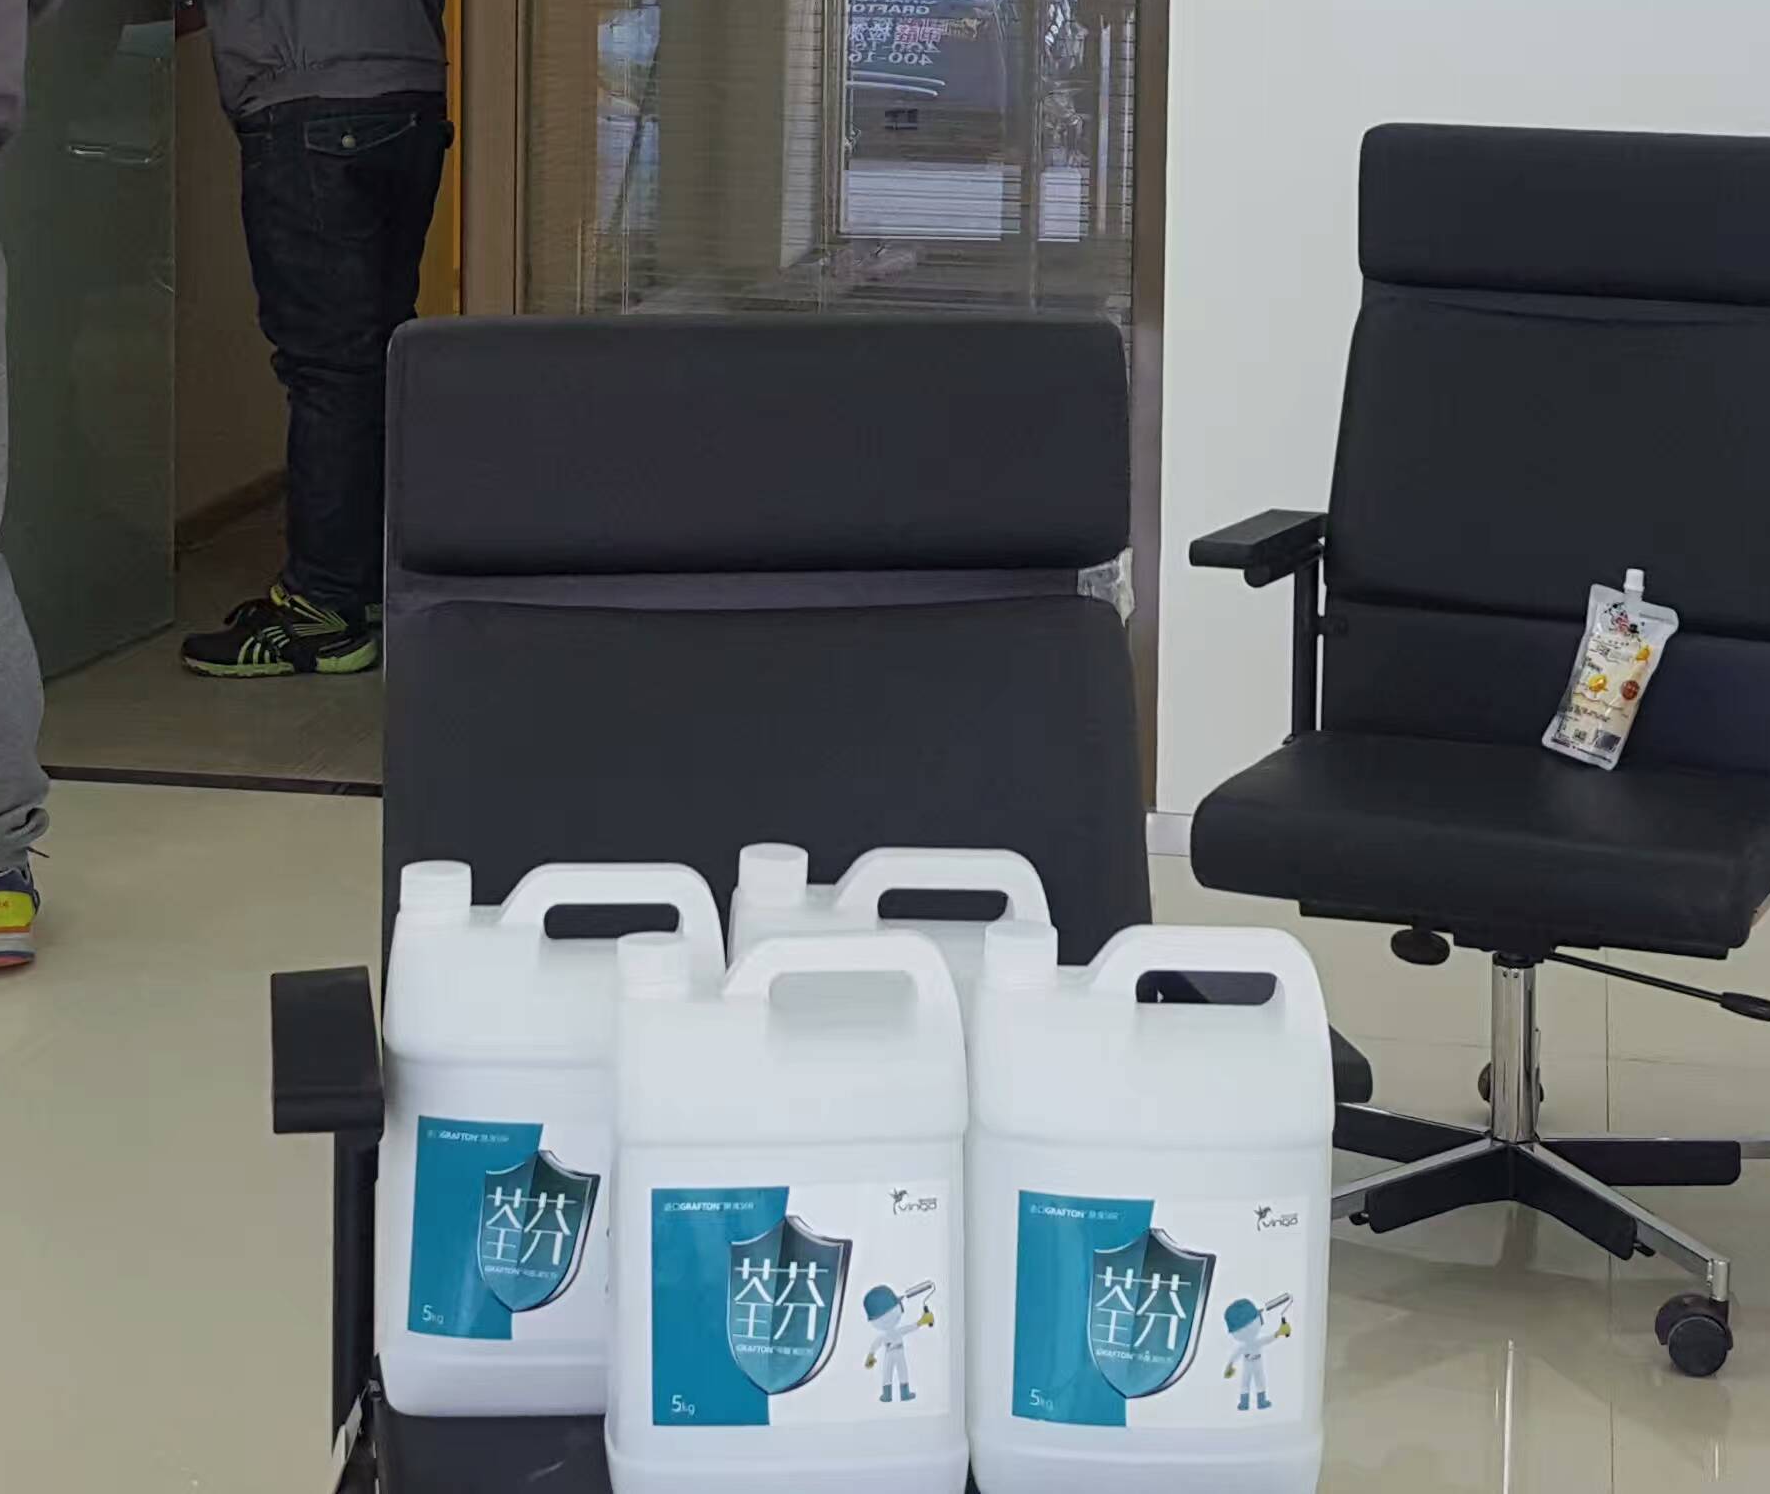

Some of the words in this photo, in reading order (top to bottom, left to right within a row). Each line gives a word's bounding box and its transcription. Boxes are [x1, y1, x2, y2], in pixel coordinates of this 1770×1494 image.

[481, 1185, 578, 1266] 荃芬
[732, 1257, 829, 1342] 荃芬
[1092, 1266, 1192, 1350] 荃芬
